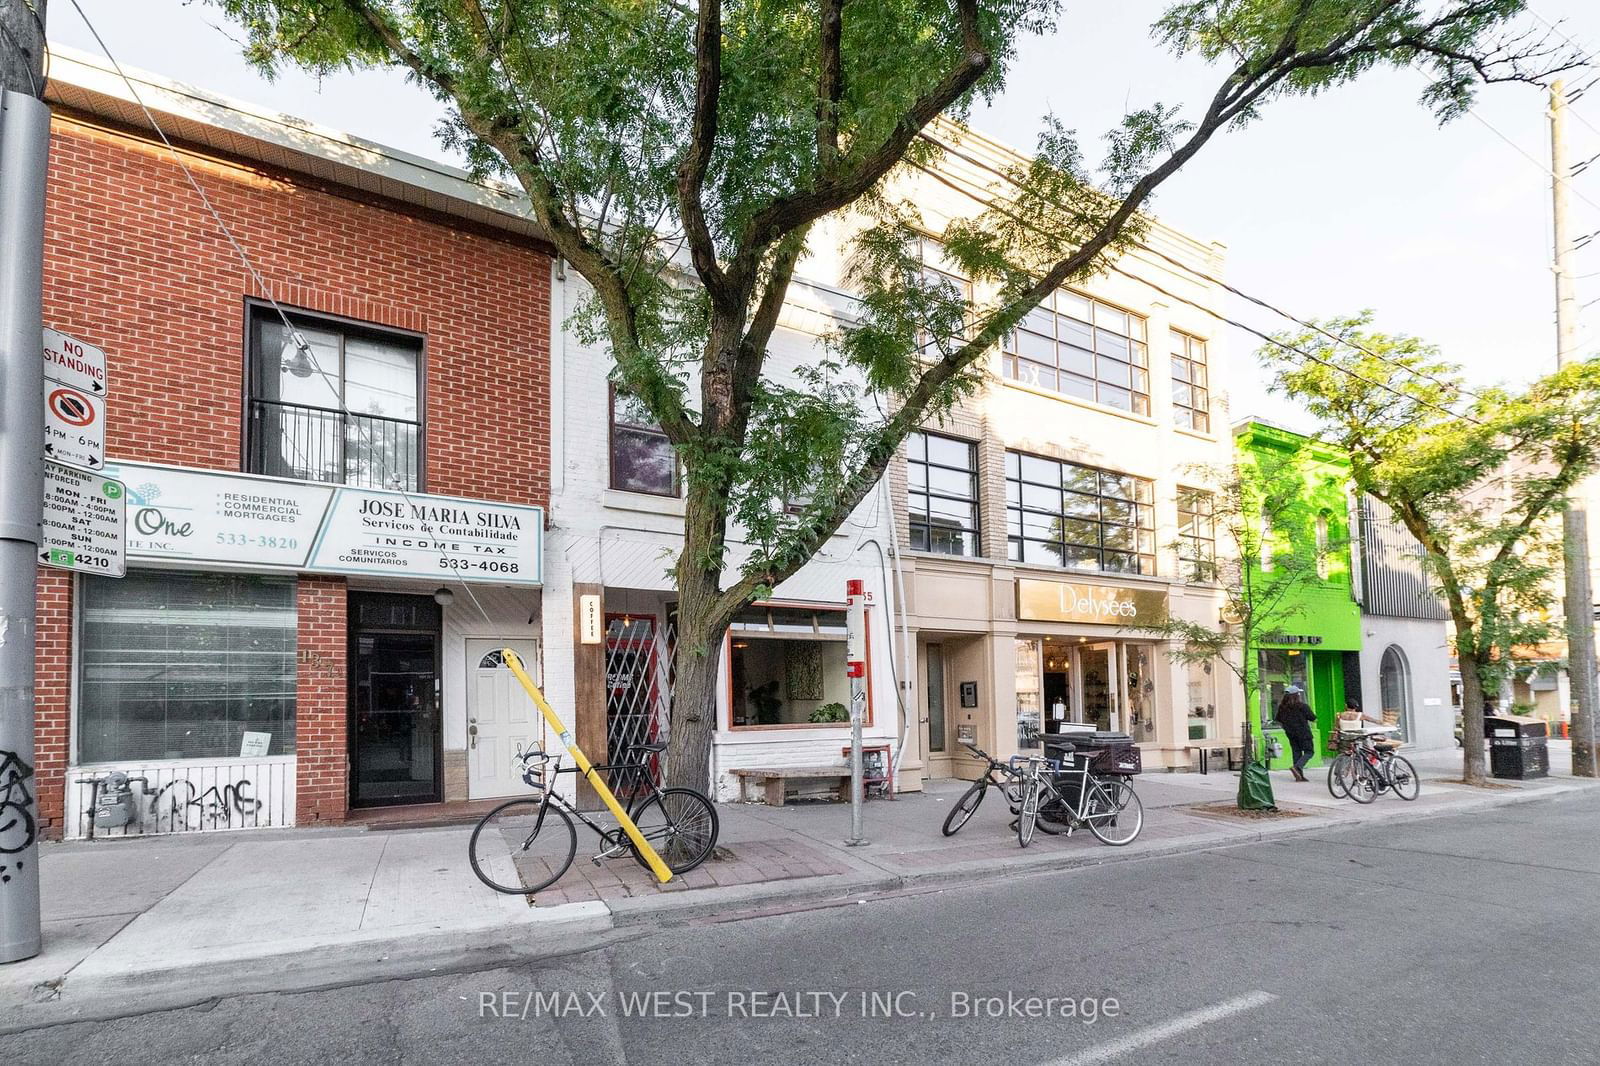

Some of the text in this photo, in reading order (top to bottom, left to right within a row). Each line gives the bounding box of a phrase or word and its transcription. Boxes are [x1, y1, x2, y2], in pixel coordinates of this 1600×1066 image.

[64, 340, 84, 358] NO
[43, 348, 103, 380] STANDING
[53, 429, 66, 440] PM
[78, 436, 86, 446] 6
[88, 440, 100, 450] PM
[44, 472, 80, 487] NFORCED
[45, 464, 92, 482] AY PARKING
[45, 493, 79, 506] 8:00AM
[86, 503, 116, 515] 4:00PM
[56, 487, 80, 498] MON
[90, 496, 107, 505] FRI
[224, 493, 299, 507] RESIDENTIAL
[224, 501, 302, 516] COMMERCIAL
[224, 510, 296, 523] MORTGAGES
[359, 499, 520, 530] JOSE MARIA SILVA
[72, 517, 92, 526] SAT
[83, 511, 118, 524] 12:00AM
[135, 508, 194, 537] One
[71, 534, 92, 543] SUN
[83, 528, 118, 540] 12:00AM
[421, 522, 434, 533] de
[440, 524, 518, 541] Contabilidade
[216, 532, 298, 550] 533-3820
[376, 537, 506, 554] INCOME TAX
[83, 544, 118, 556] 12:00AM
[75, 554, 109, 567] 4210
[339, 555, 408, 567] COMUNITARIOS
[351, 549, 519, 573] SERVICOS 533-4068
